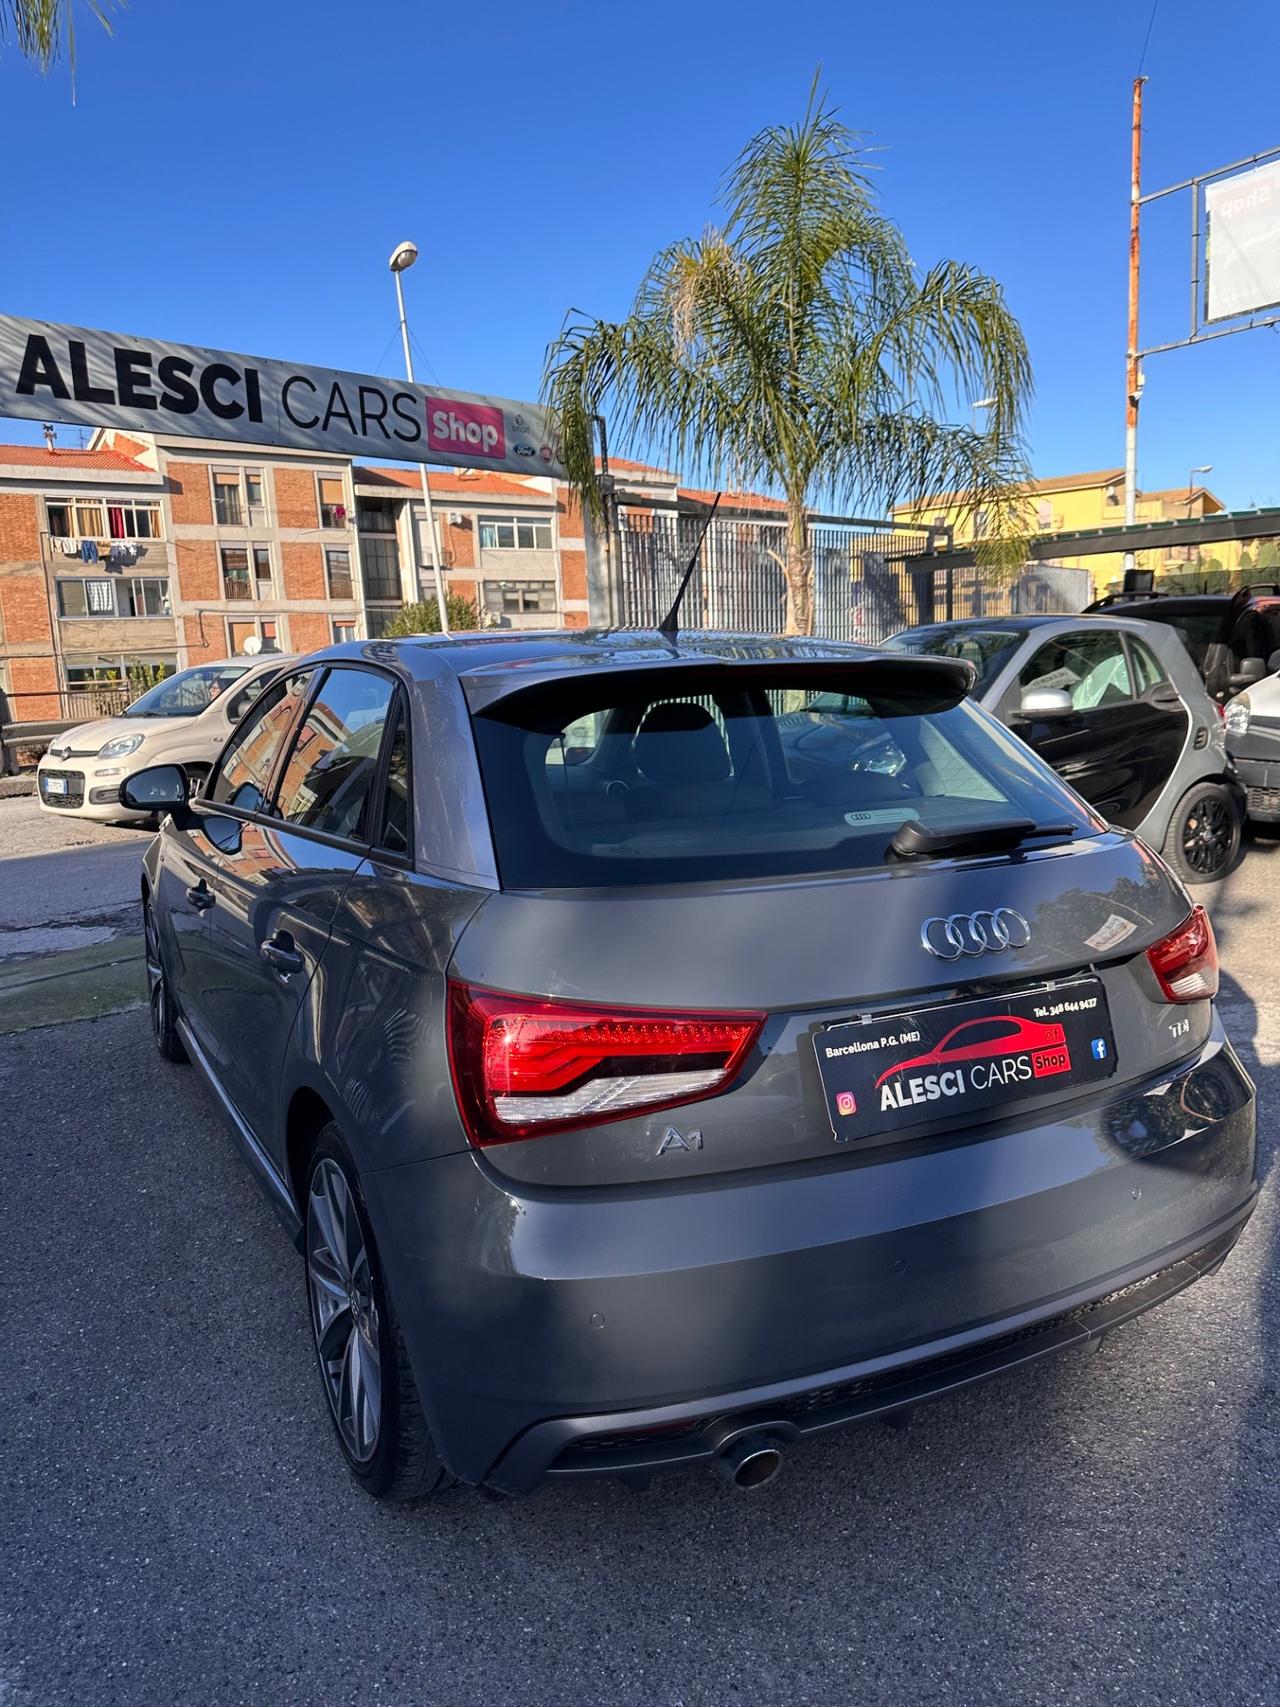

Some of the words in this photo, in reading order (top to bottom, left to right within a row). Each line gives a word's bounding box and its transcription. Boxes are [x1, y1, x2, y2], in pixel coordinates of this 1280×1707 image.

[16, 333, 263, 423] ALESCI
[281, 375, 422, 443] CARS
[433, 410, 498, 452] Shop
[1033, 1006, 1049, 1017] Tel.
[1049, 1003, 1064, 1016] 348
[1064, 1001, 1079, 1012] 644
[1079, 998, 1097, 1010] 9437
[825, 1040, 880, 1058] Barcellona
[880, 1035, 899, 1048] P.G.
[900, 1030, 920, 1044] (ME)
[880, 1069, 966, 1111] ALESCI
[970, 1055, 1032, 1090] CARS
[1035, 1055, 1066, 1069] Shop
[656, 1127, 704, 1157] A1
